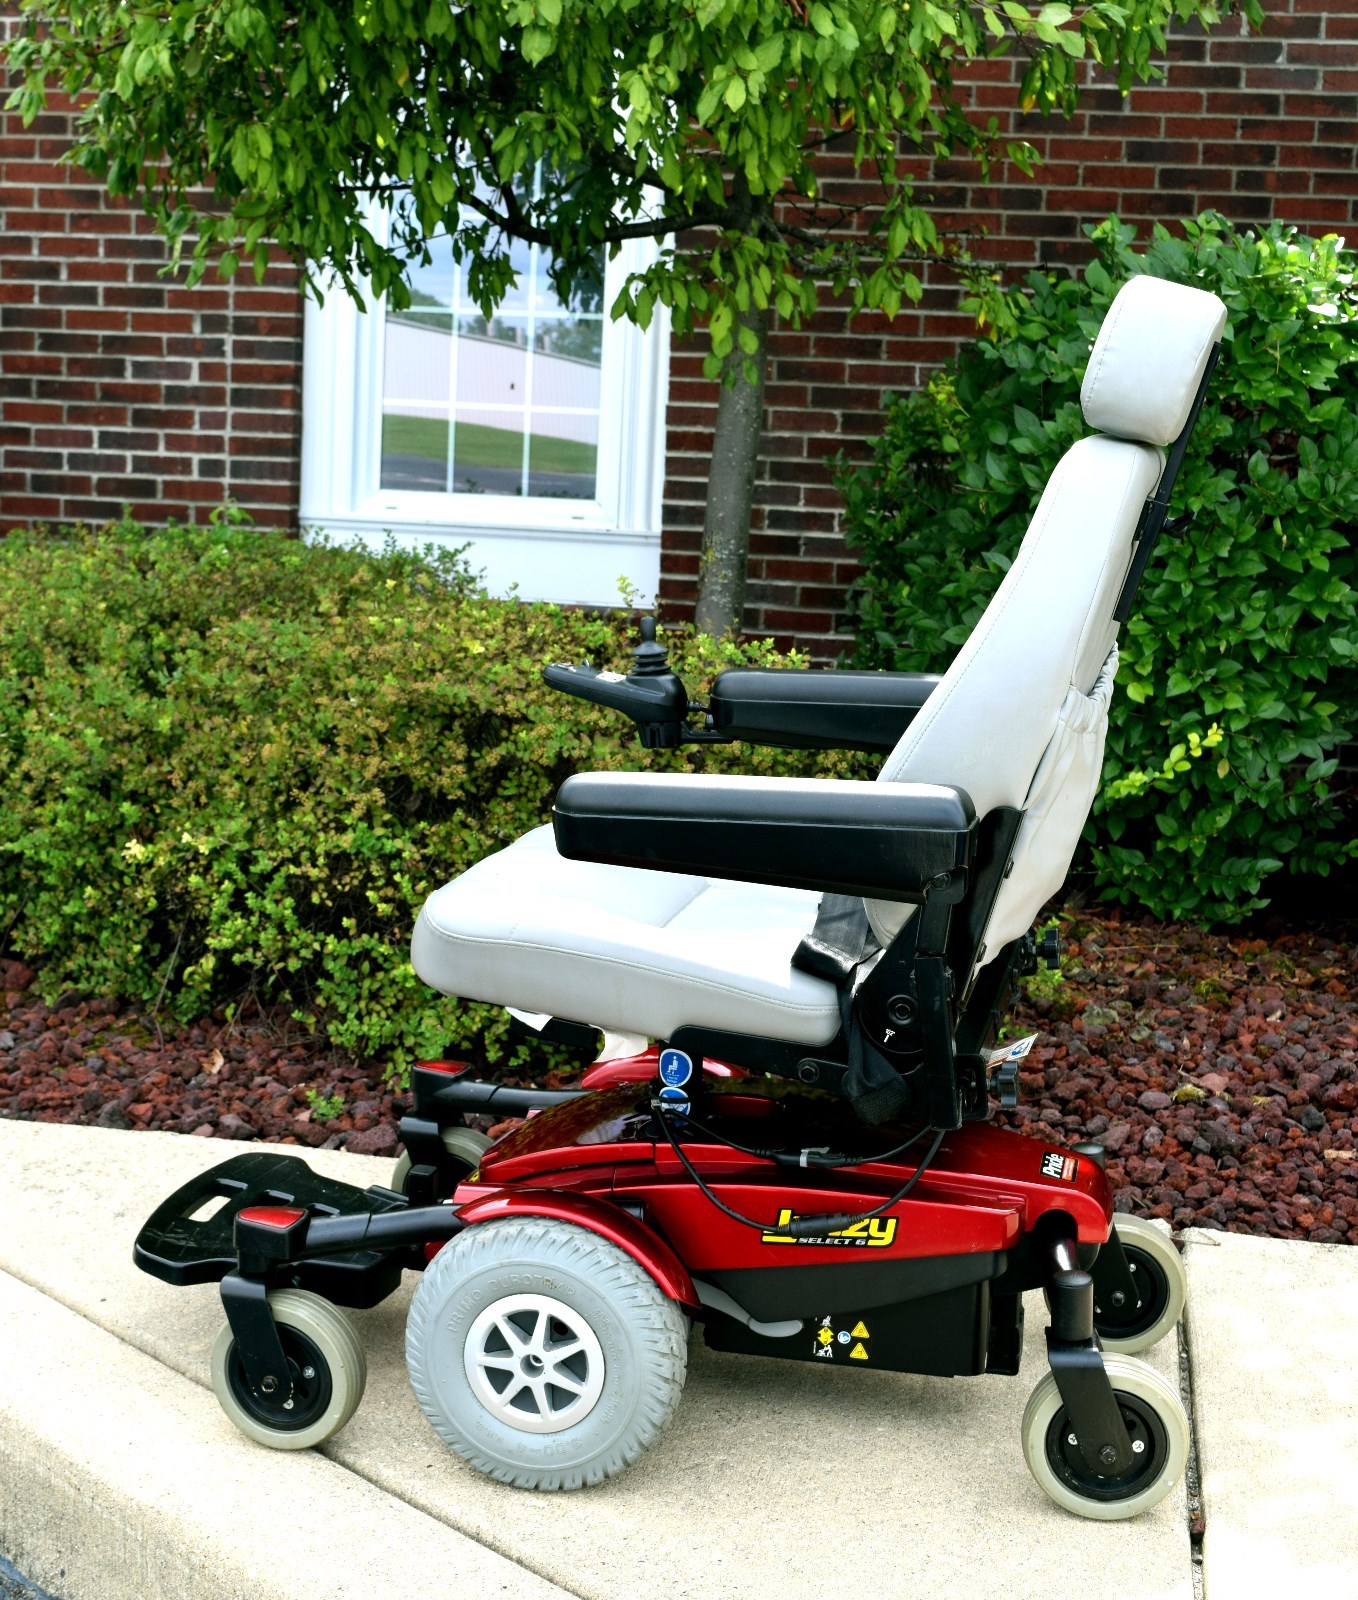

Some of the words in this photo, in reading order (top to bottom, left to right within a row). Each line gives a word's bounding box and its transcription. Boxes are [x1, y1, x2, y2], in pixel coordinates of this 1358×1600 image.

[1042, 1153, 1064, 1179] Pride
[762, 1209, 897, 1246] Jzy
[798, 1236, 852, 1246] SELECT
[854, 1237, 866, 1246] 6
[446, 1288, 483, 1334] PRIMO
